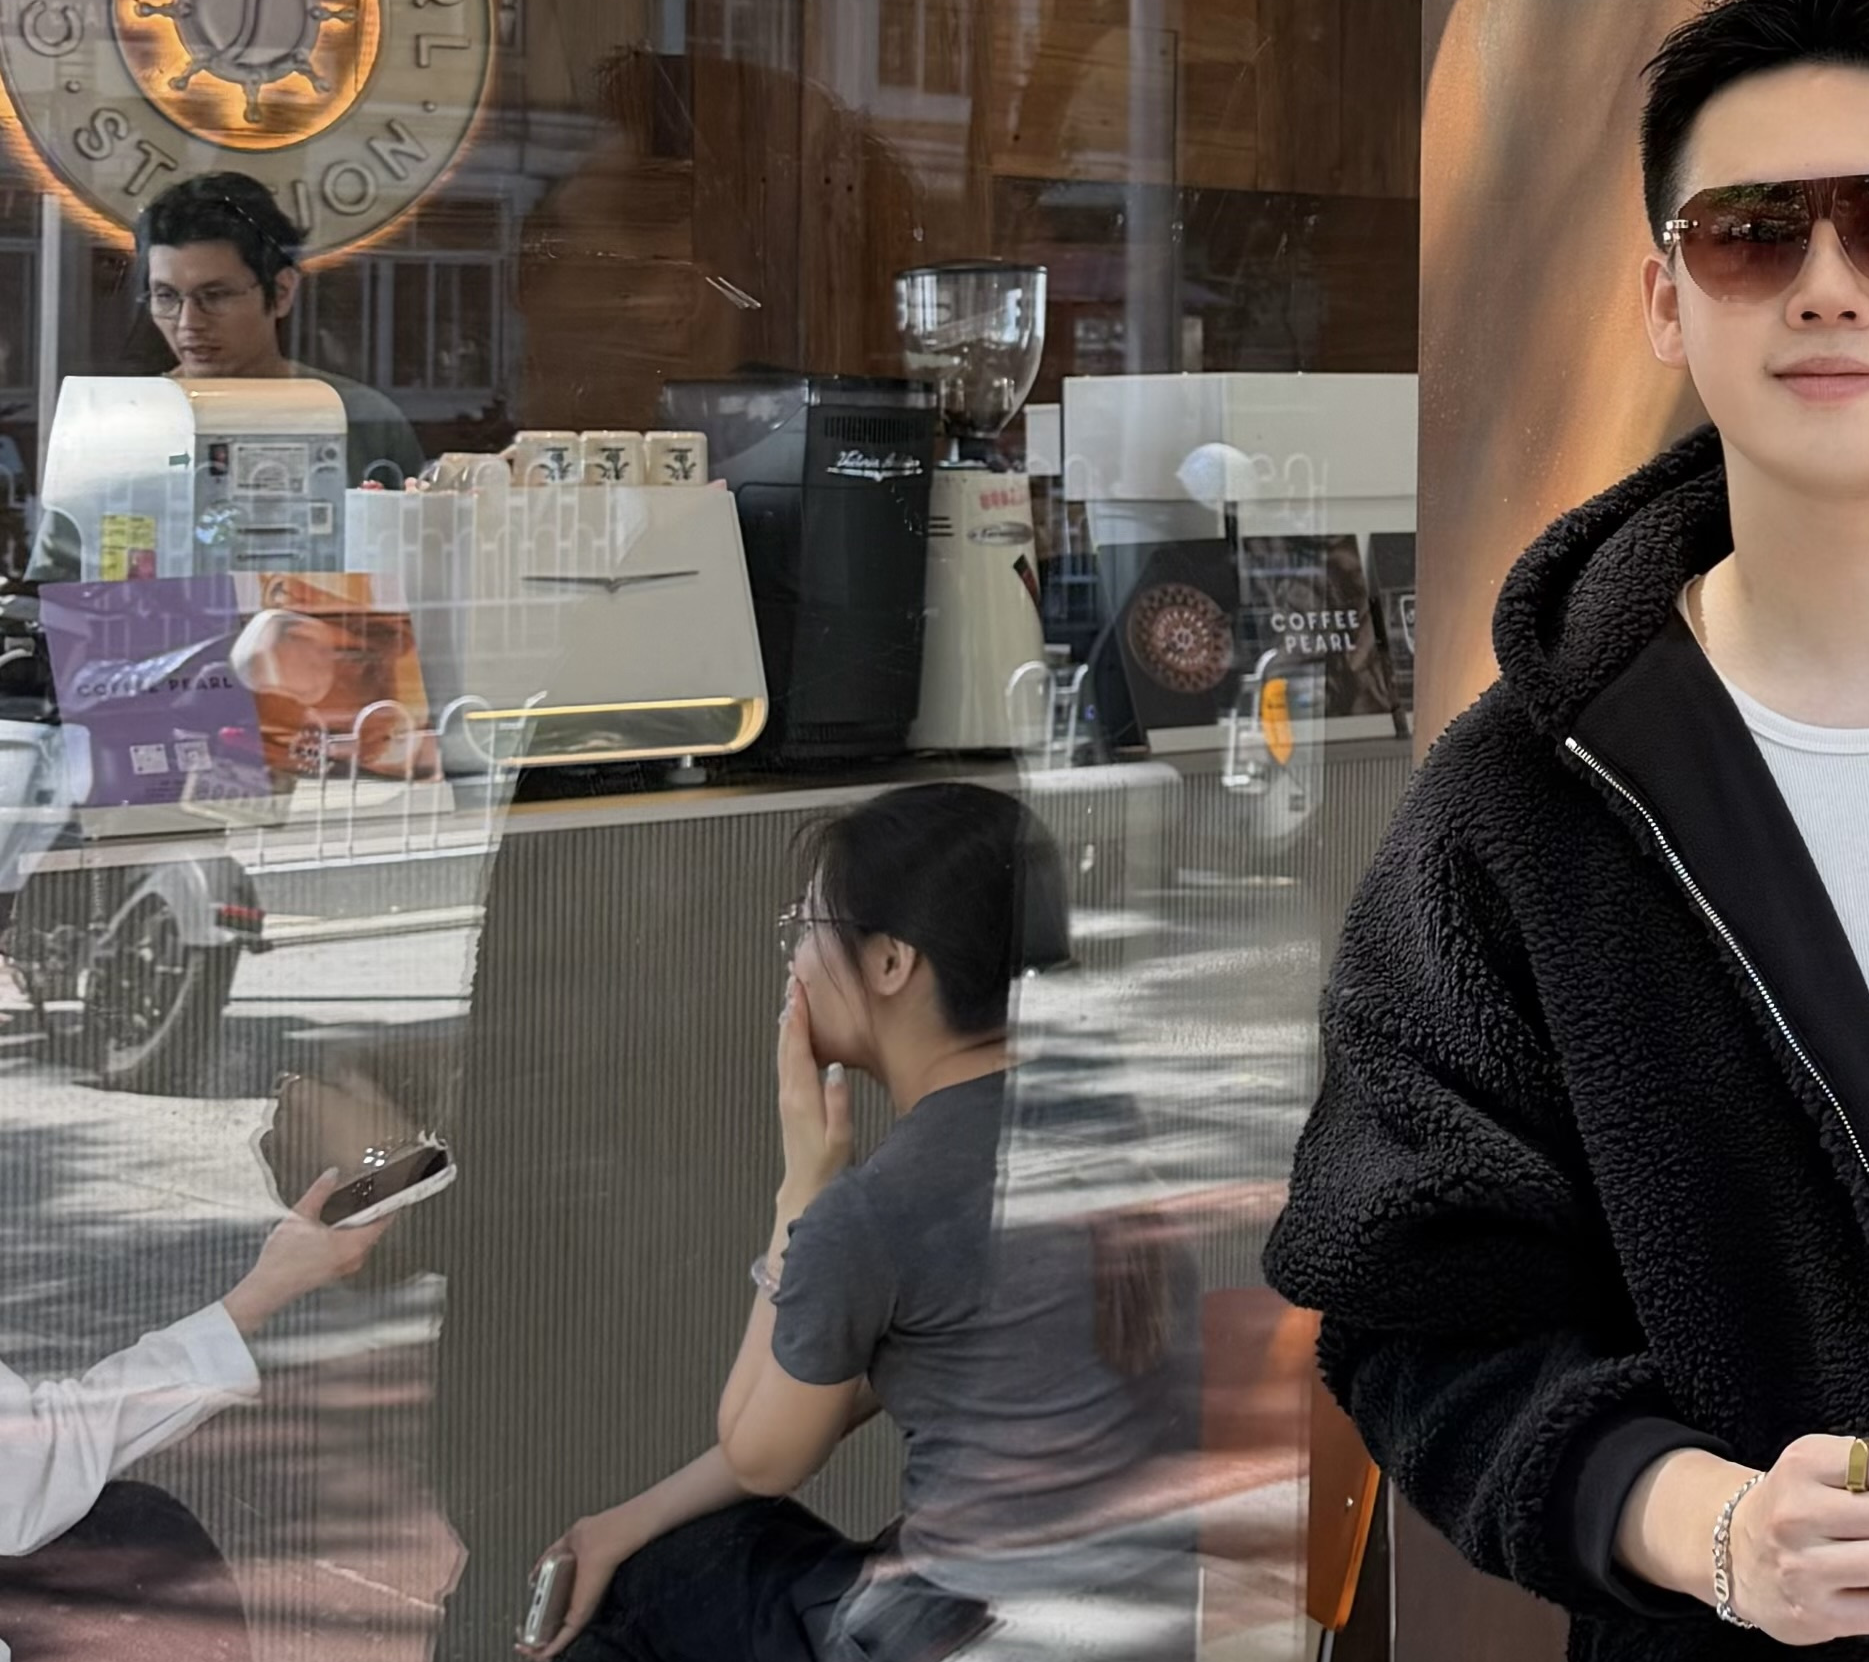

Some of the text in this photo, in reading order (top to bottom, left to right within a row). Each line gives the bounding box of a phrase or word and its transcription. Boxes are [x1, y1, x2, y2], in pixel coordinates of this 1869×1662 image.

[73, 106, 433, 231] STION
[1271, 609, 1360, 633] COFFEE
[1285, 632, 1357, 654] PEARL
